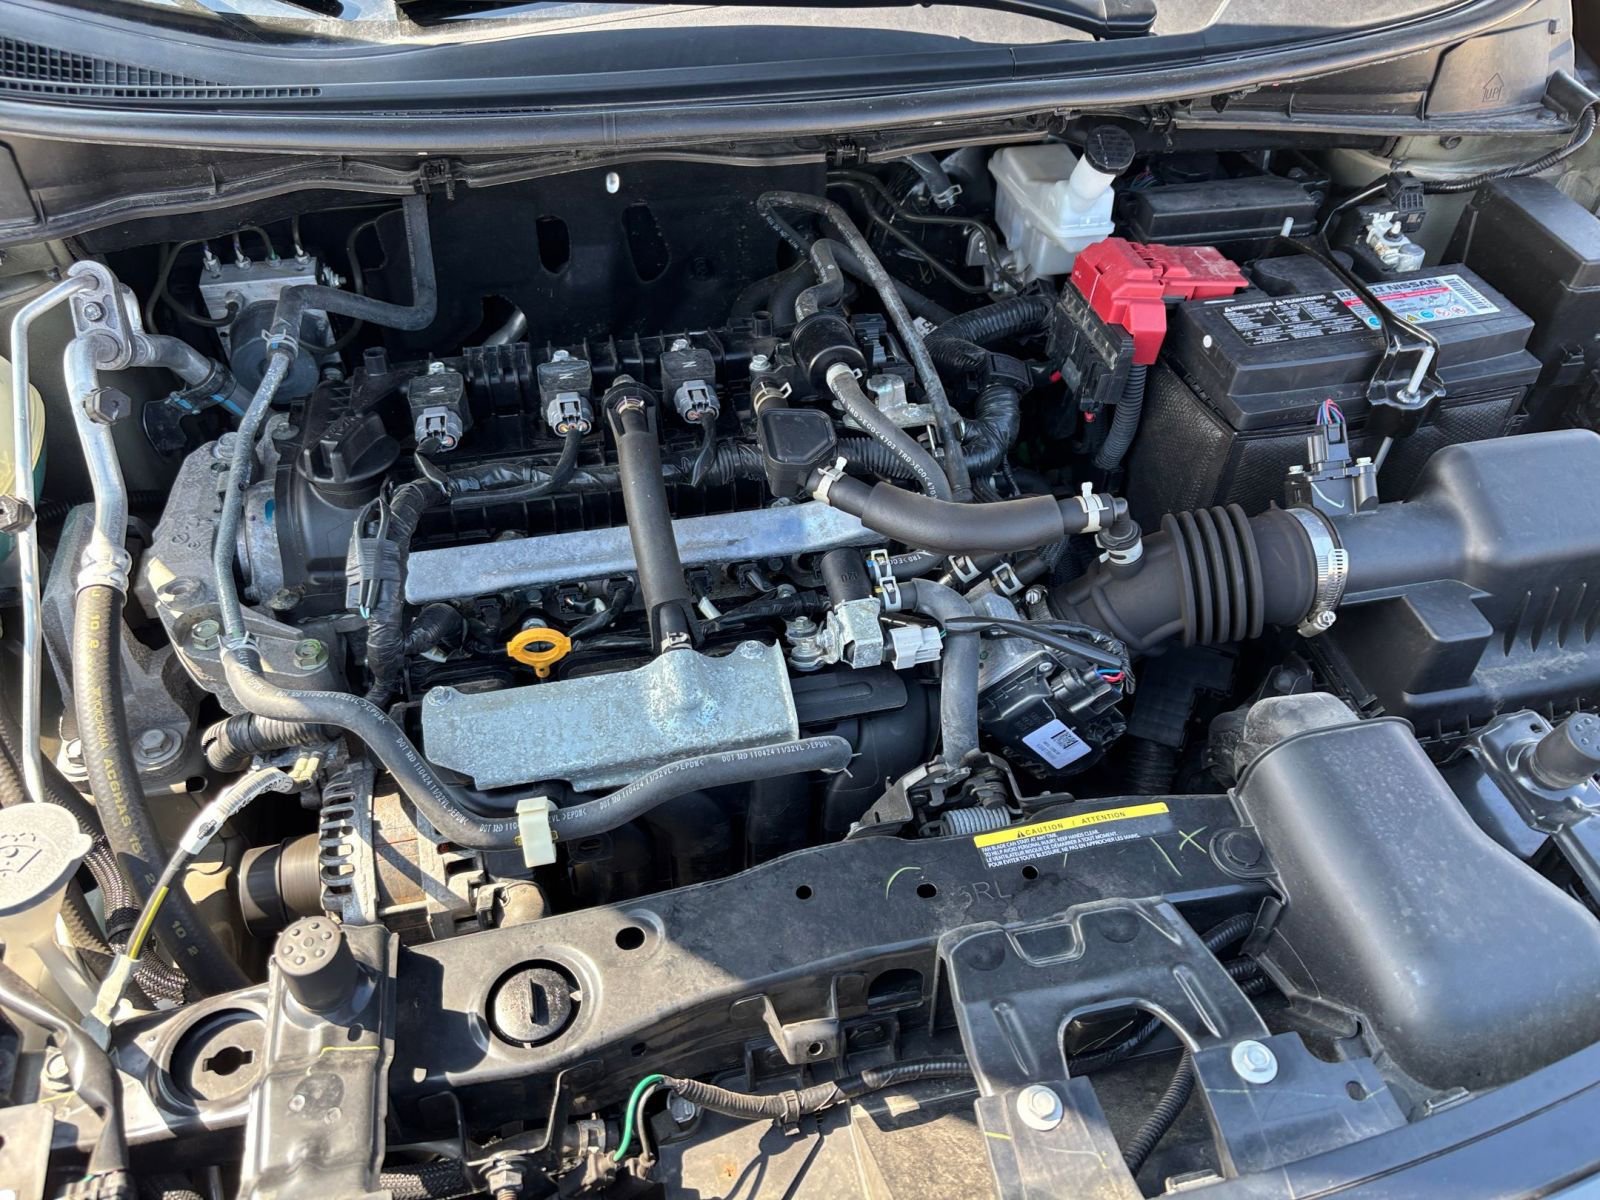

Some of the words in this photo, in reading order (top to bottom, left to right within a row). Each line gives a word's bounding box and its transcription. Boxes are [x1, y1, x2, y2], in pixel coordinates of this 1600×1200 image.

[1388, 279, 1440, 291] NISSAN
[93, 698, 110, 750] YOKOHAMA
[171, 919, 188, 939] 10
[188, 945, 199, 957] 2
[1025, 823, 1064, 836] CAUTION
[1081, 811, 1127, 824] ATTENTION
